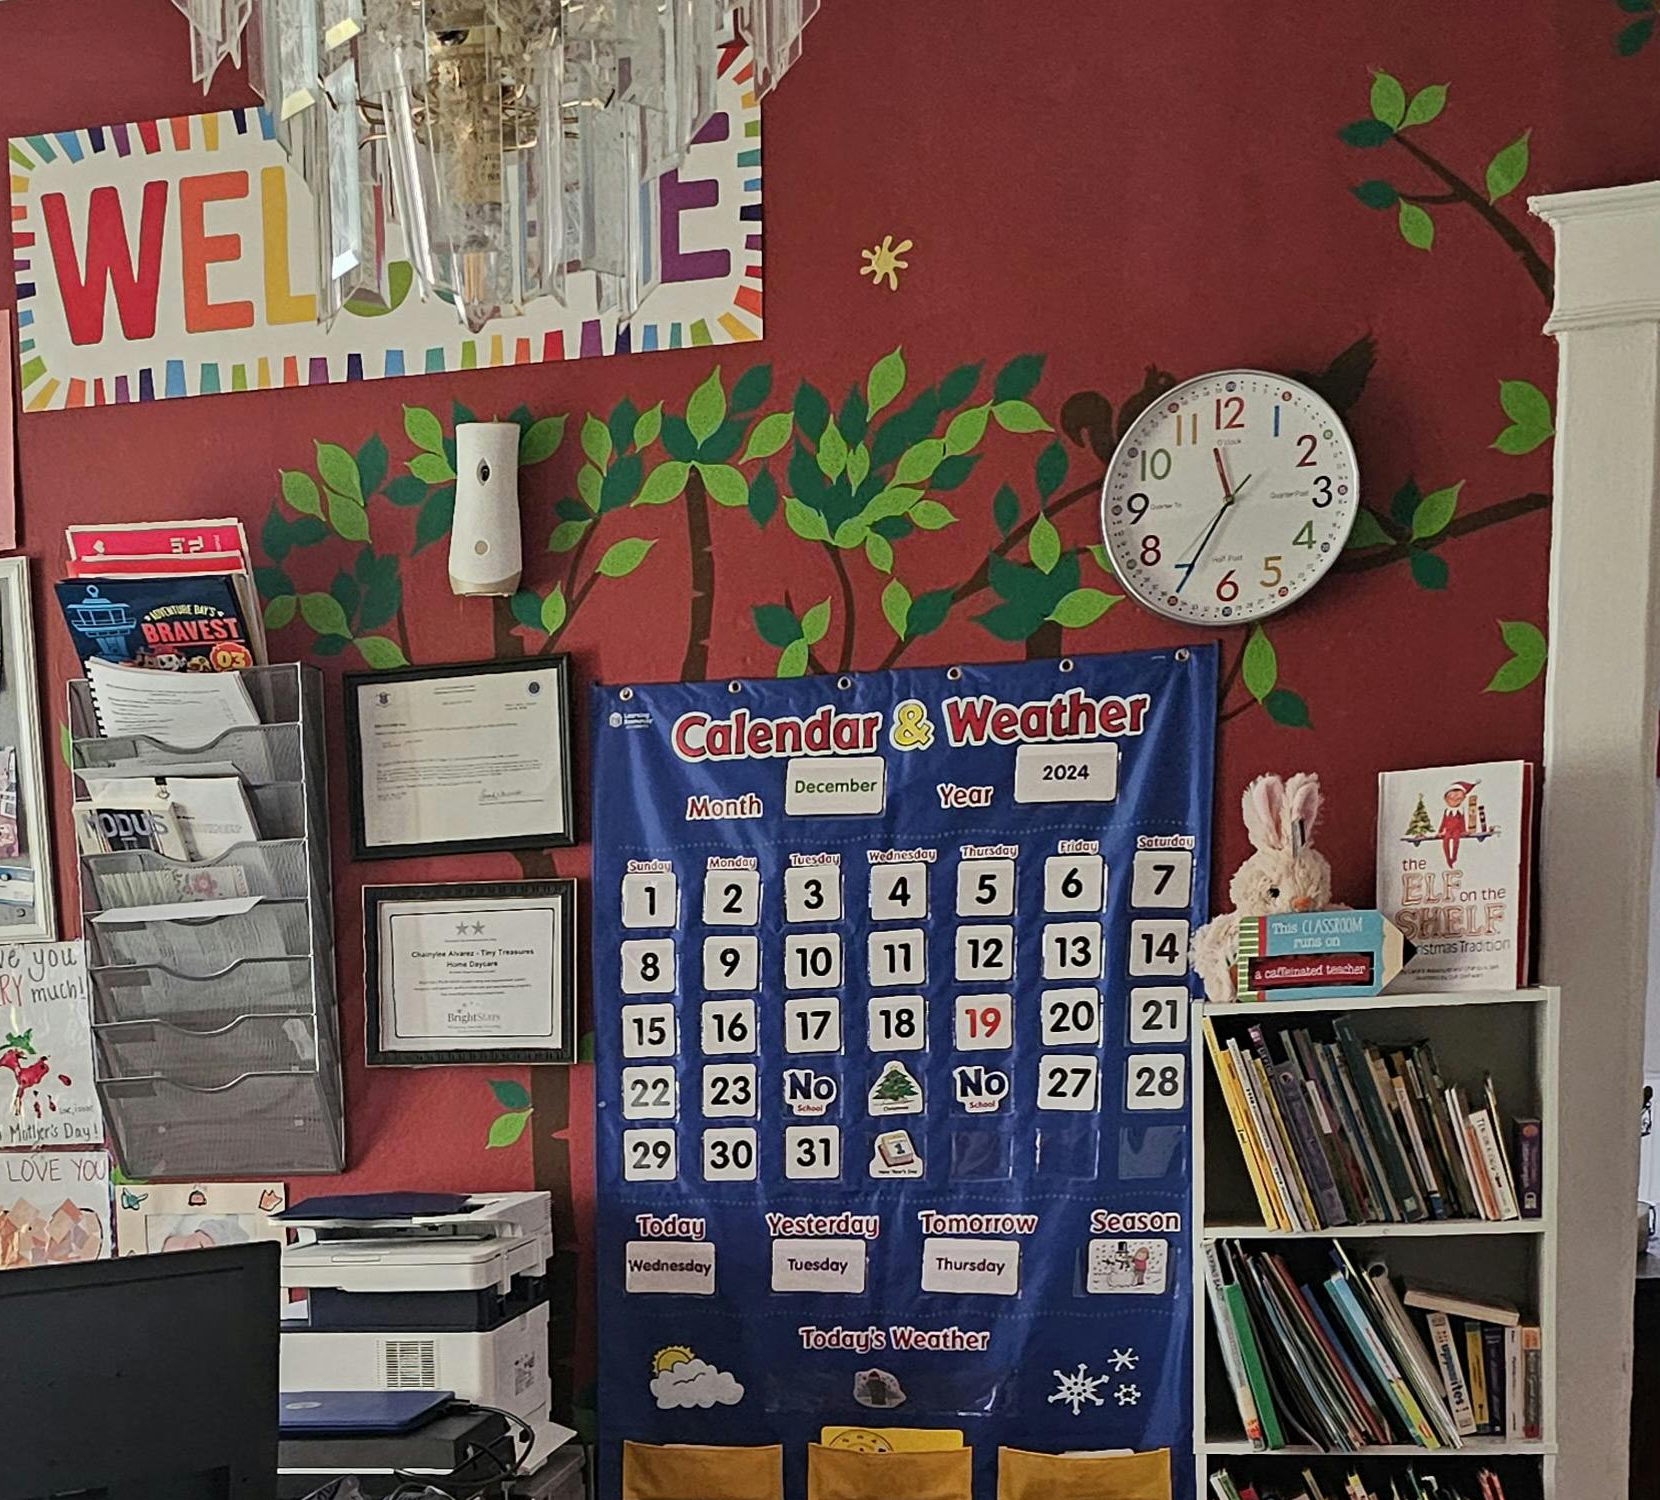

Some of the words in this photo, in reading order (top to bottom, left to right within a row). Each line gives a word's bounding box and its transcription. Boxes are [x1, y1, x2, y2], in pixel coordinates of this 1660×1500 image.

[41, 111, 731, 345] WELE
[1216, 397, 1245, 430] 12
[1274, 405, 1280, 437] 1
[1177, 413, 1197, 446] 11
[1141, 448, 1171, 481] 10
[1295, 435, 1317, 467] 2
[1312, 476, 1332, 508] 3
[1127, 493, 1149, 525] 9
[1292, 520, 1316, 549] 4
[1141, 535, 1161, 566] 8
[1174, 563, 1195, 593] 7
[1216, 569, 1239, 602] 6
[1260, 556, 1282, 587] 5
[141, 618, 240, 646] BRAVEST
[674, 707, 881, 759] Calendar
[891, 700, 934, 750] &
[945, 689, 1149, 745] Weather
[794, 777, 877, 796] December
[1042, 764, 1090, 782] 2024
[688, 795, 762, 819] Month
[939, 785, 993, 808] Year
[868, 849, 936, 864] Wednesday
[961, 846, 1018, 859] Thursday
[1060, 842, 1098, 854] Friday
[1138, 837, 1194, 849] Saturday
[628, 861, 671, 872] Sunday
[708, 857, 756, 869] Monday
[790, 854, 839, 866] Tuesday
[1402, 859, 1427, 871] the
[804, 879, 824, 910] 3
[888, 877, 912, 907] 4
[975, 875, 997, 905] 5
[1061, 868, 1083, 899] 6
[1153, 865, 1176, 895] 7
[1402, 870, 1463, 905] ELF
[1460, 890, 1477, 902] on
[1481, 888, 1506, 900] the
[644, 886, 657, 916] 1
[723, 885, 742, 914] 2
[1272, 922, 1298, 935] This
[1302, 917, 1363, 934] CLASSROOM
[1395, 903, 1507, 940] SHELF
[498, 948, 534, 956] Treasures
[883, 942, 912, 973] 11
[967, 938, 1005, 969] 12
[1054, 936, 1093, 966] 13
[1141, 932, 1180, 964] 14
[1293, 937, 1322, 949] runs
[1325, 937, 1340, 947] on
[1460, 939, 1510, 953] Tradition
[28, 947, 77, 982] you
[469, 960, 498, 969] Daycare
[640, 952, 660, 982] 8
[720, 949, 740, 978] 9
[796, 946, 833, 977] 10
[1254, 971, 1262, 980] a
[1265, 965, 1323, 979] caffeinated
[1326, 963, 1366, 975] teacher
[31, 977, 87, 1003] much!
[712, 1013, 748, 1042] 16
[796, 1010, 832, 1040] 17
[879, 1008, 916, 1039] 18
[965, 1007, 1002, 1039] 19
[1050, 1002, 1095, 1033] 20
[1141, 1000, 1178, 1031] 21
[633, 1017, 666, 1046] 15
[630, 1077, 670, 1108] 22
[710, 1076, 752, 1106] 23
[789, 1071, 834, 1100] No
[957, 1068, 1007, 1097] No
[1047, 1068, 1091, 1098] 27
[1136, 1067, 1180, 1096] 28
[797, 1104, 823, 1112] School
[969, 1100, 996, 1109] School
[632, 1140, 671, 1169] 29
[710, 1140, 752, 1169] 30
[797, 1138, 831, 1167] 31
[7, 1158, 62, 1182] LOVE
[71, 1159, 106, 1182] YOU
[637, 1215, 705, 1238] Today
[767, 1214, 879, 1238] Yesterday
[919, 1213, 1038, 1235] Tomorrow
[1090, 1211, 1181, 1234] Season
[628, 1257, 712, 1277] Wednesday
[788, 1257, 848, 1275] Tuesday
[937, 1256, 1005, 1275] Thursday
[799, 1327, 886, 1353] Today's
[892, 1329, 989, 1351] Weather
